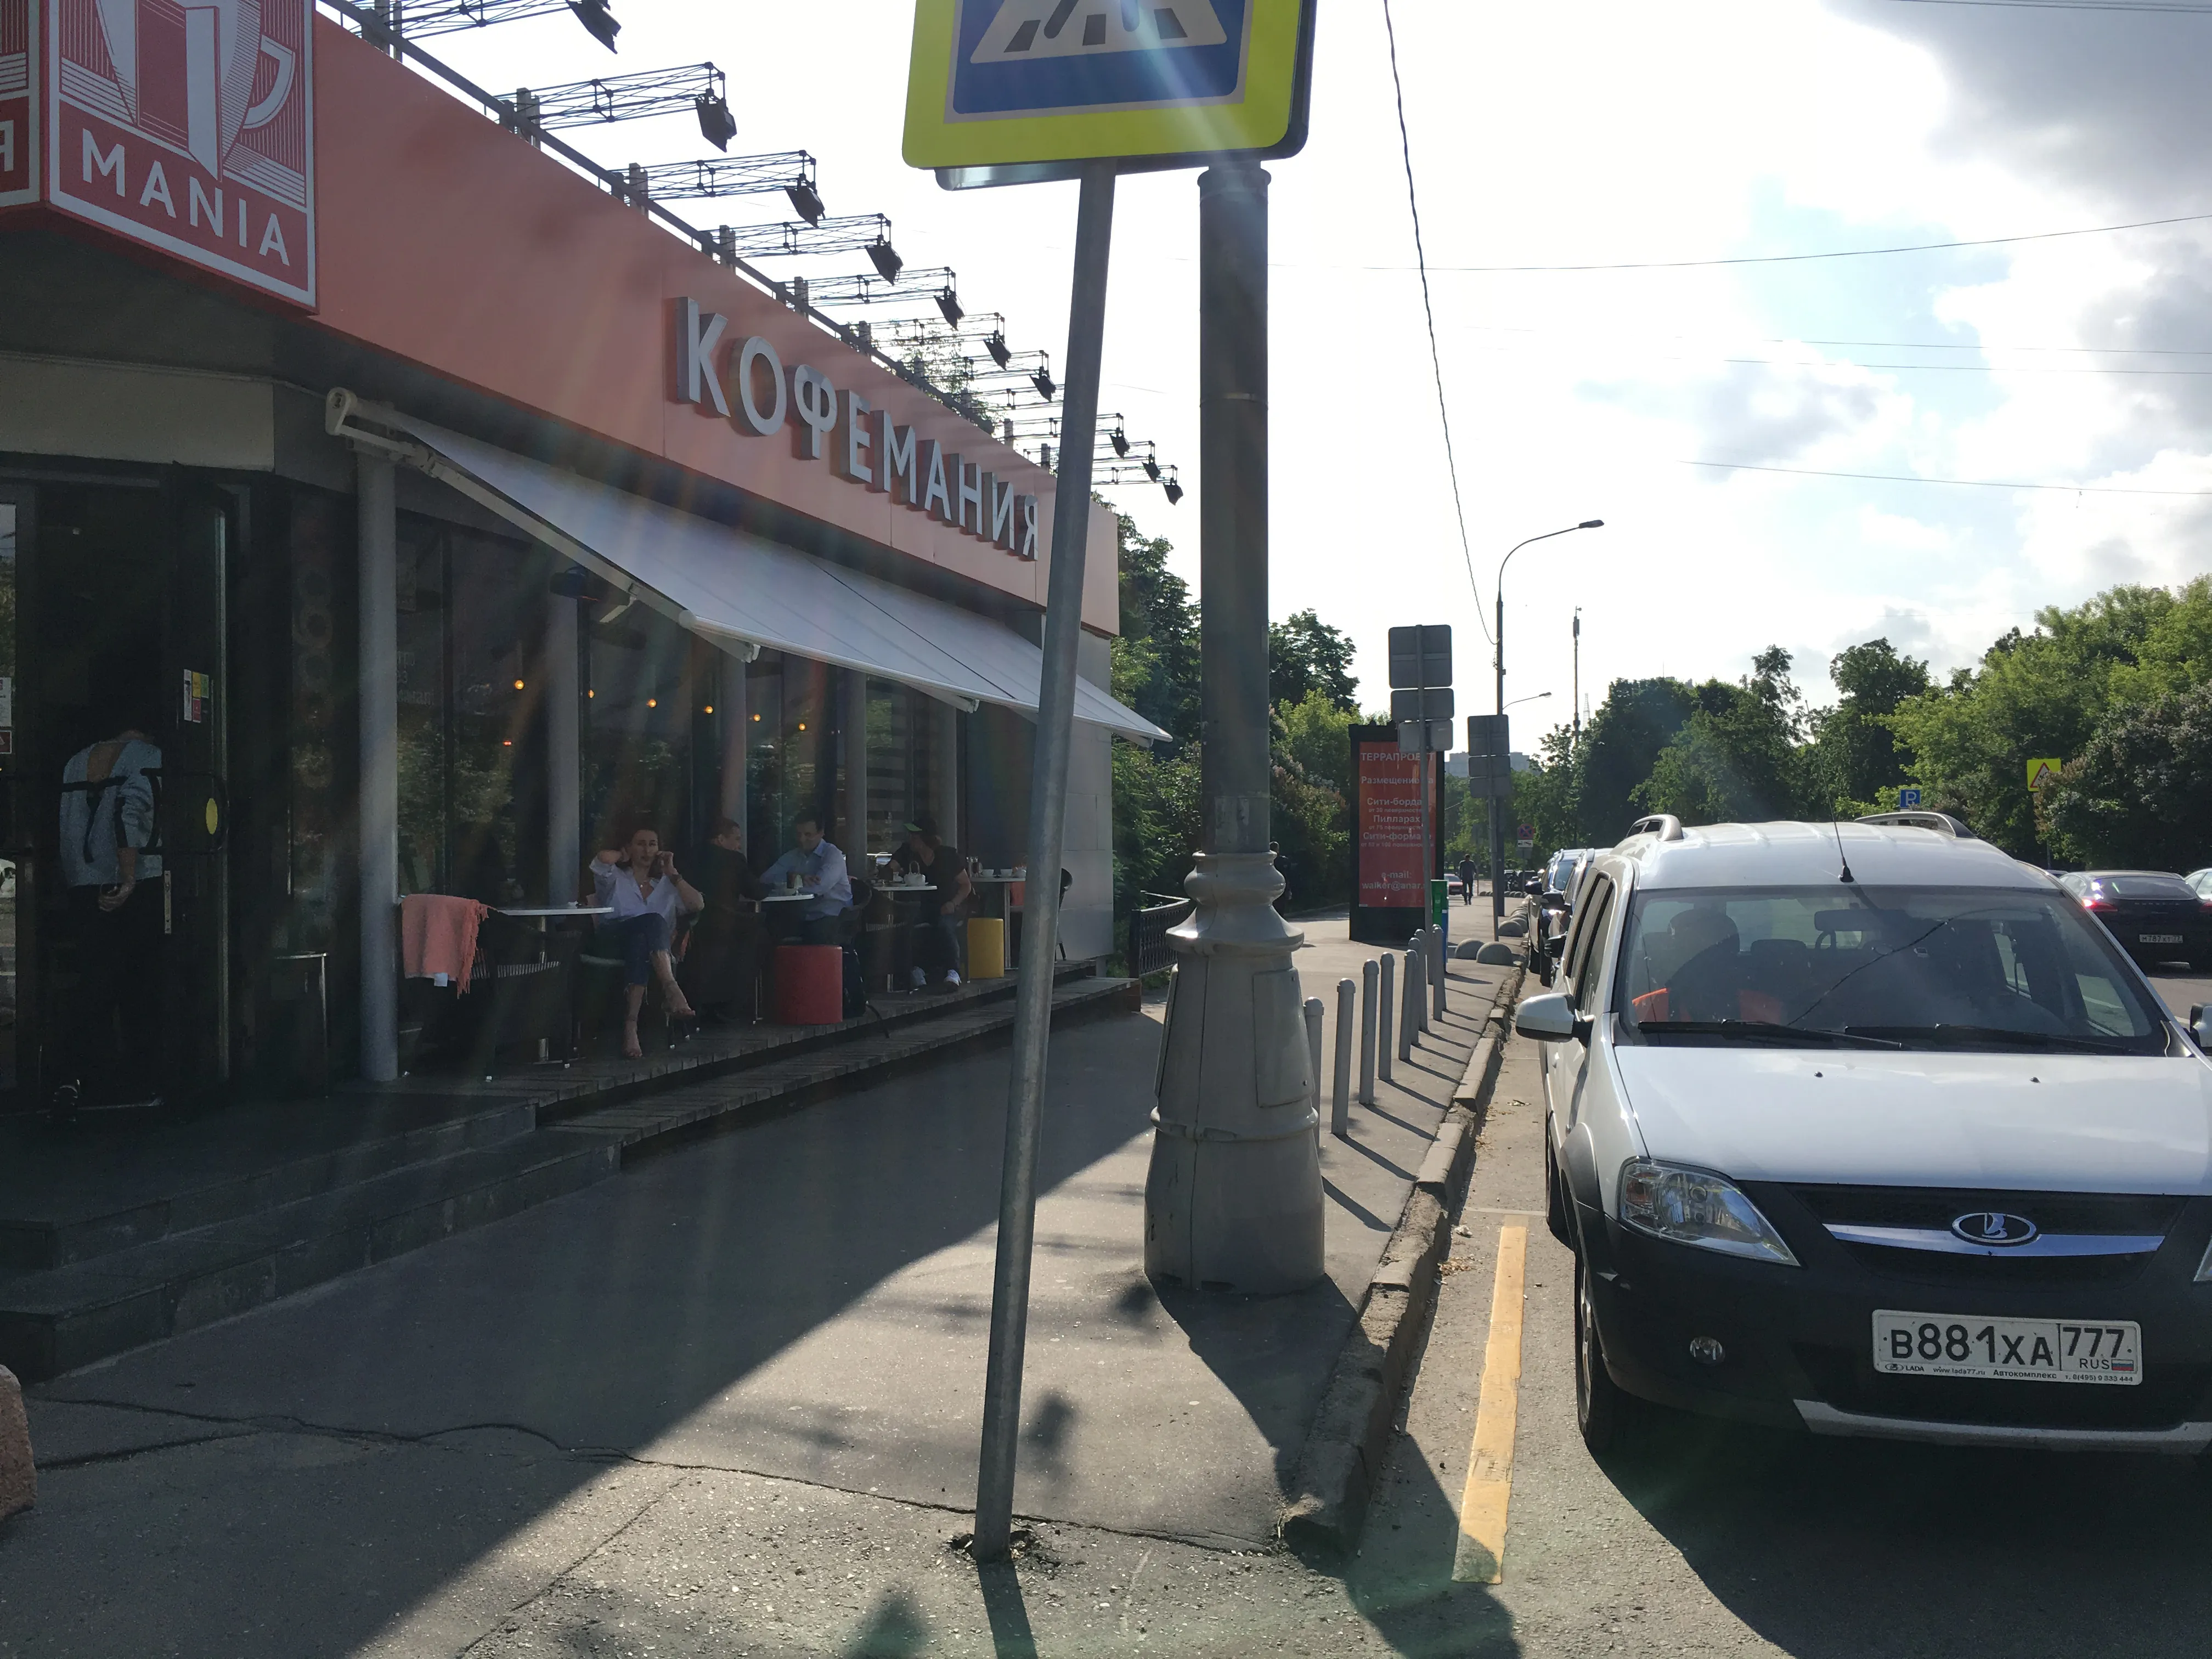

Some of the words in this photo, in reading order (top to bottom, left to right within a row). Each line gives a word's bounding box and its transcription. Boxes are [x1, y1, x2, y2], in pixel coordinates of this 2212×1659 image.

[82, 127, 290, 267] MANIA
[680, 296, 1039, 561] КОФЕМАНИЯ
[1361, 753, 1435, 761] ТЕРРАПРОЕТ
[1361, 776, 1420, 785] Размещение
[1367, 798, 1423, 806] Сити-борда
[1373, 815, 1420, 824] Пилларах
[1362, 881, 1425, 891] walker@anar.
[1890, 1323, 2054, 1367] В881ХА
[2062, 1326, 2125, 1358] 777
[2079, 1358, 2111, 1370] RUS
[1933, 1367, 1986, 1375] www.lada77.ru
[1993, 1369, 2057, 1380] Автокомплекс
